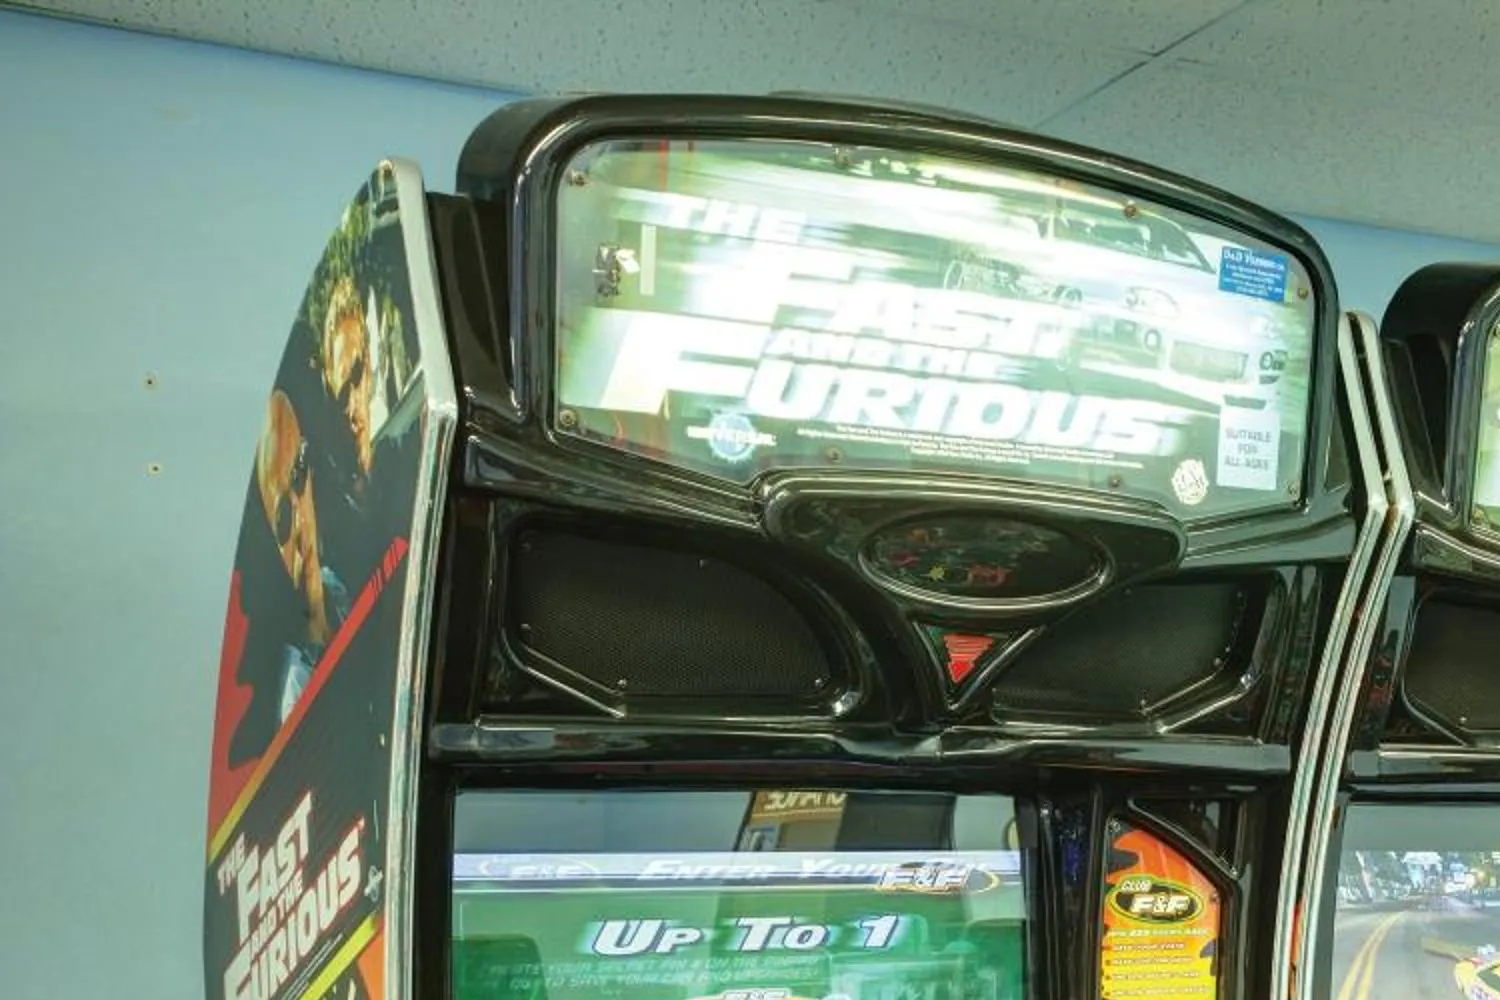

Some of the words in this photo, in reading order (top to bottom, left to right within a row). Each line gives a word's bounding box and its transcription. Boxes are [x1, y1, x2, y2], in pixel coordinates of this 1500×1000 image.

[668, 198, 806, 243] THE
[695, 243, 1068, 358] FAST
[602, 310, 1178, 456] FURIOUS
[217, 831, 246, 896] THE
[237, 791, 312, 948] FAST
[249, 908, 278, 951] AND
[276, 868, 304, 918] THE
[592, 917, 704, 956] UP
[737, 916, 830, 952] TO
[859, 913, 902, 950] 1
